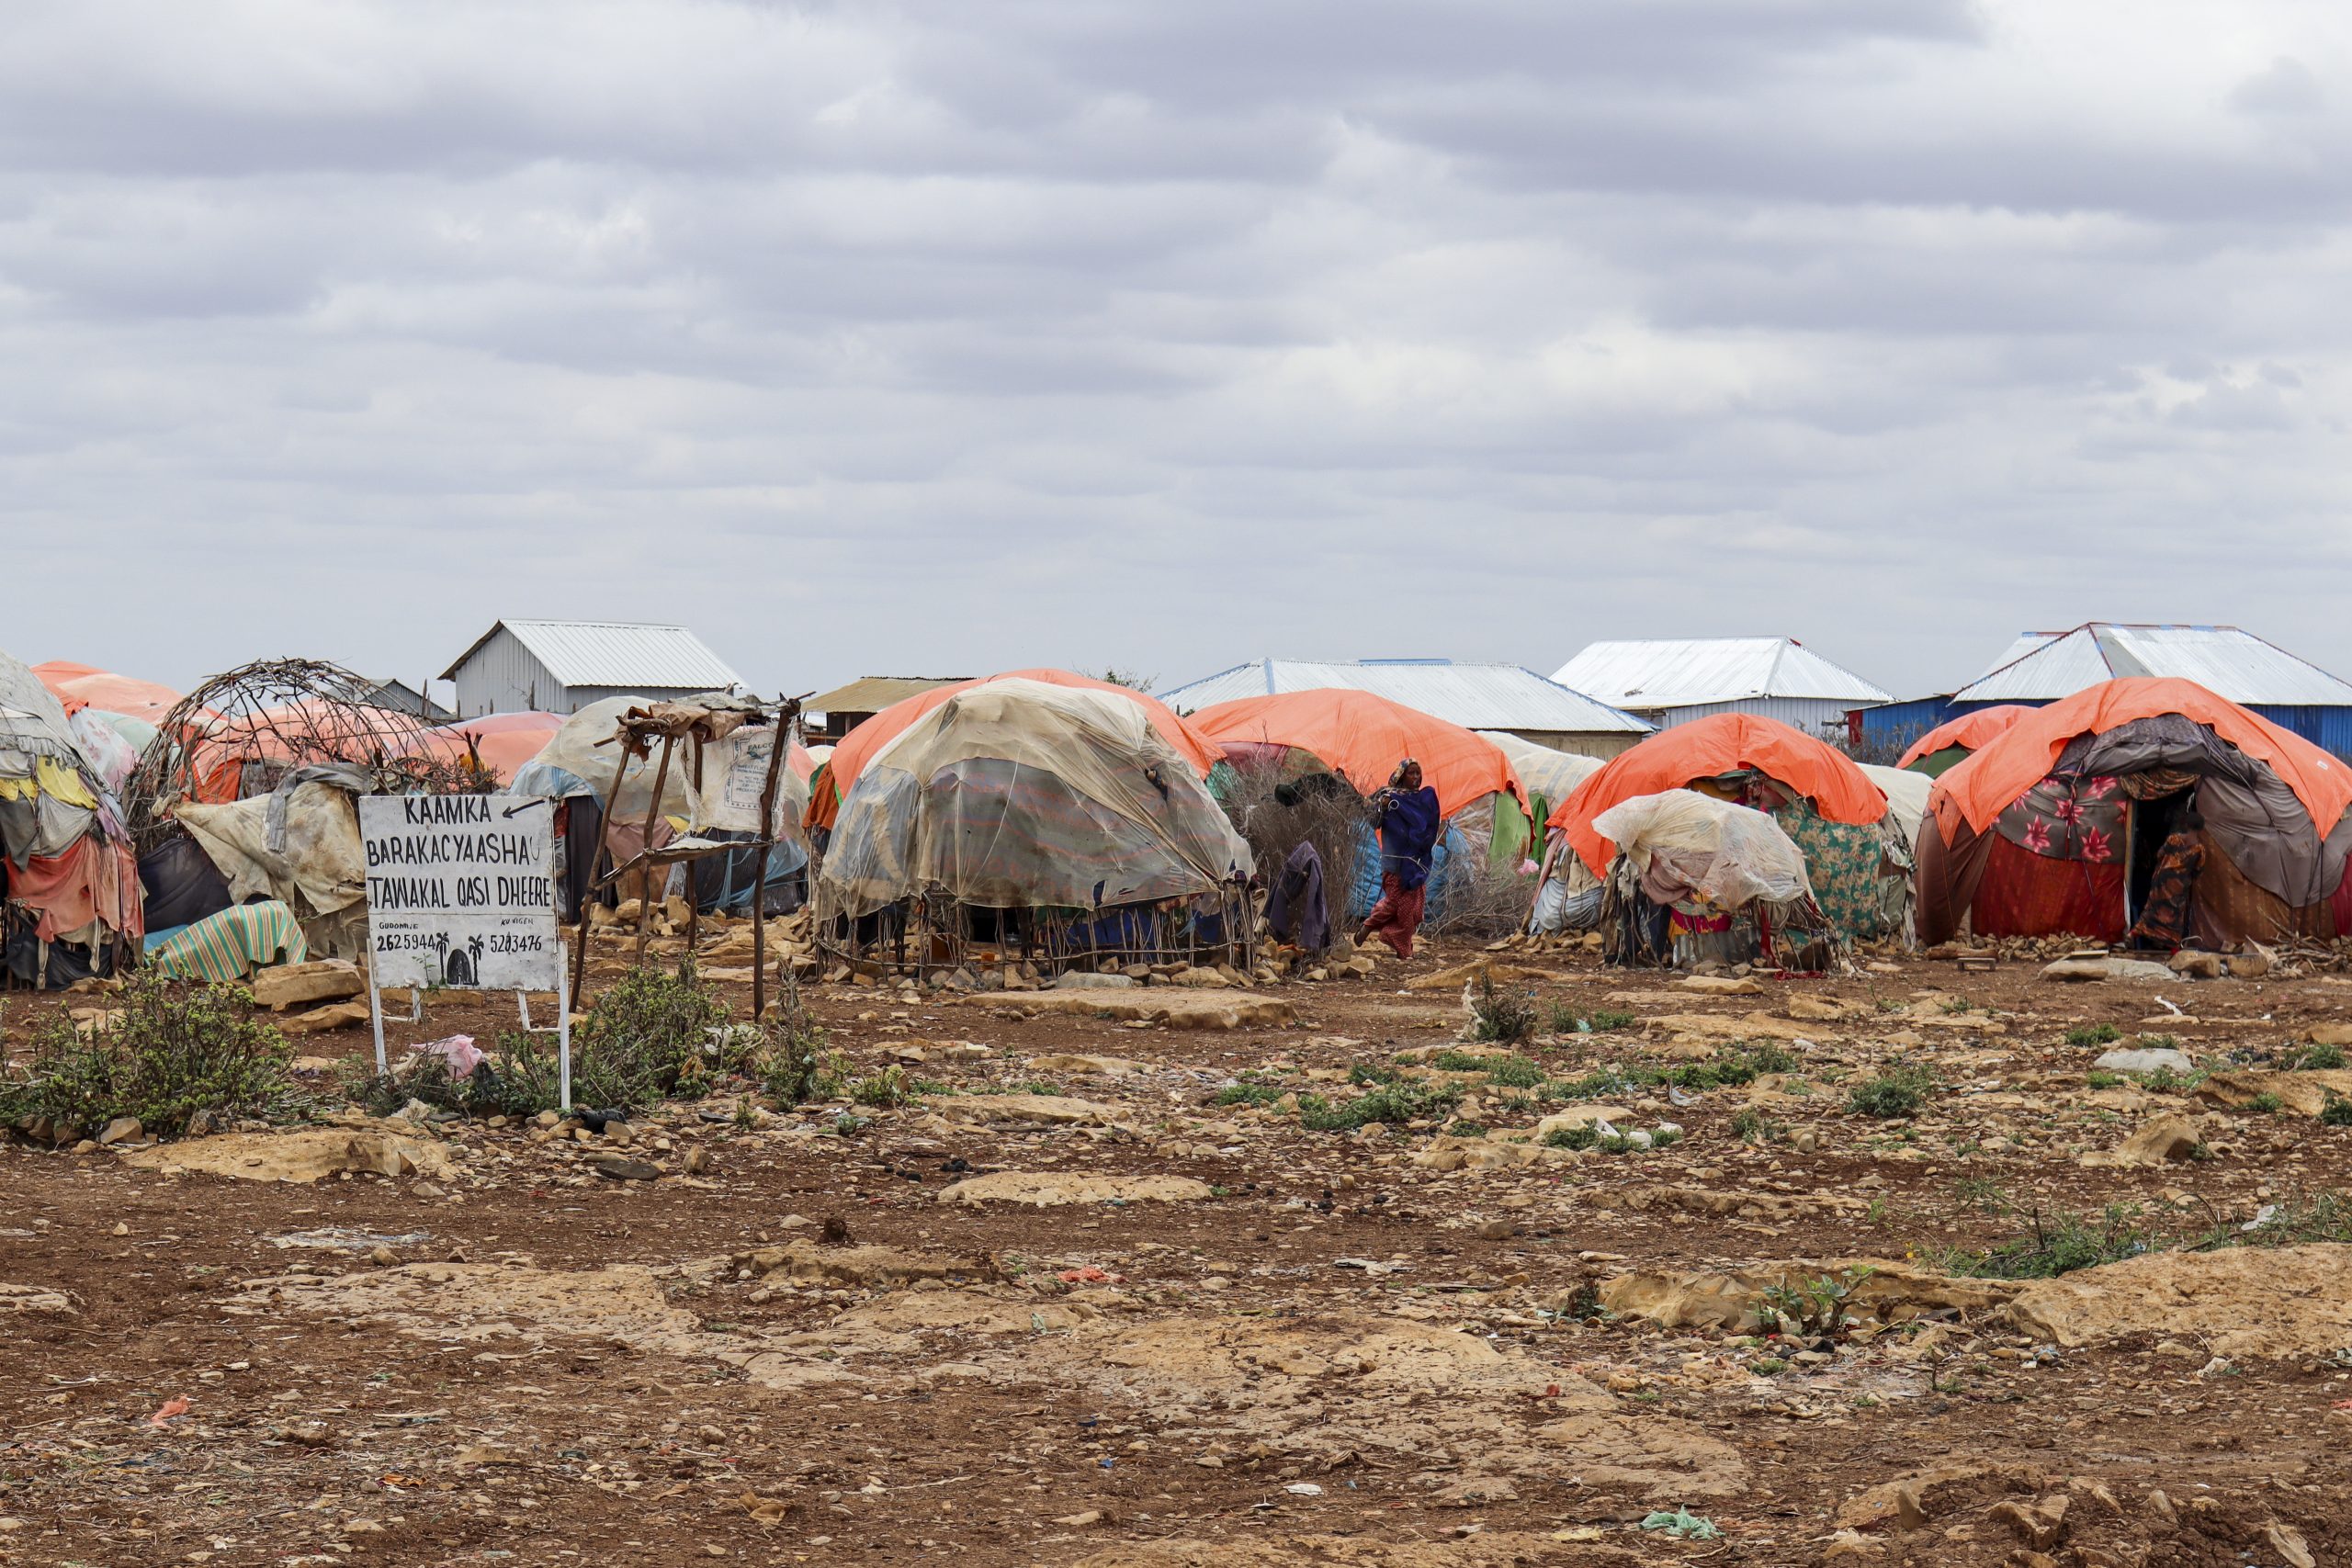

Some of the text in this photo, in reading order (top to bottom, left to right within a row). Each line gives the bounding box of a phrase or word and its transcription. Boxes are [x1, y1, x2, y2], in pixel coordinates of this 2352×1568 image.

[748, 742, 774, 750] FALCO
[404, 796, 492, 825] KAAMKA
[368, 876, 549, 909] TAWAKAL QASI DHEERE
[377, 933, 436, 952] 2625944
